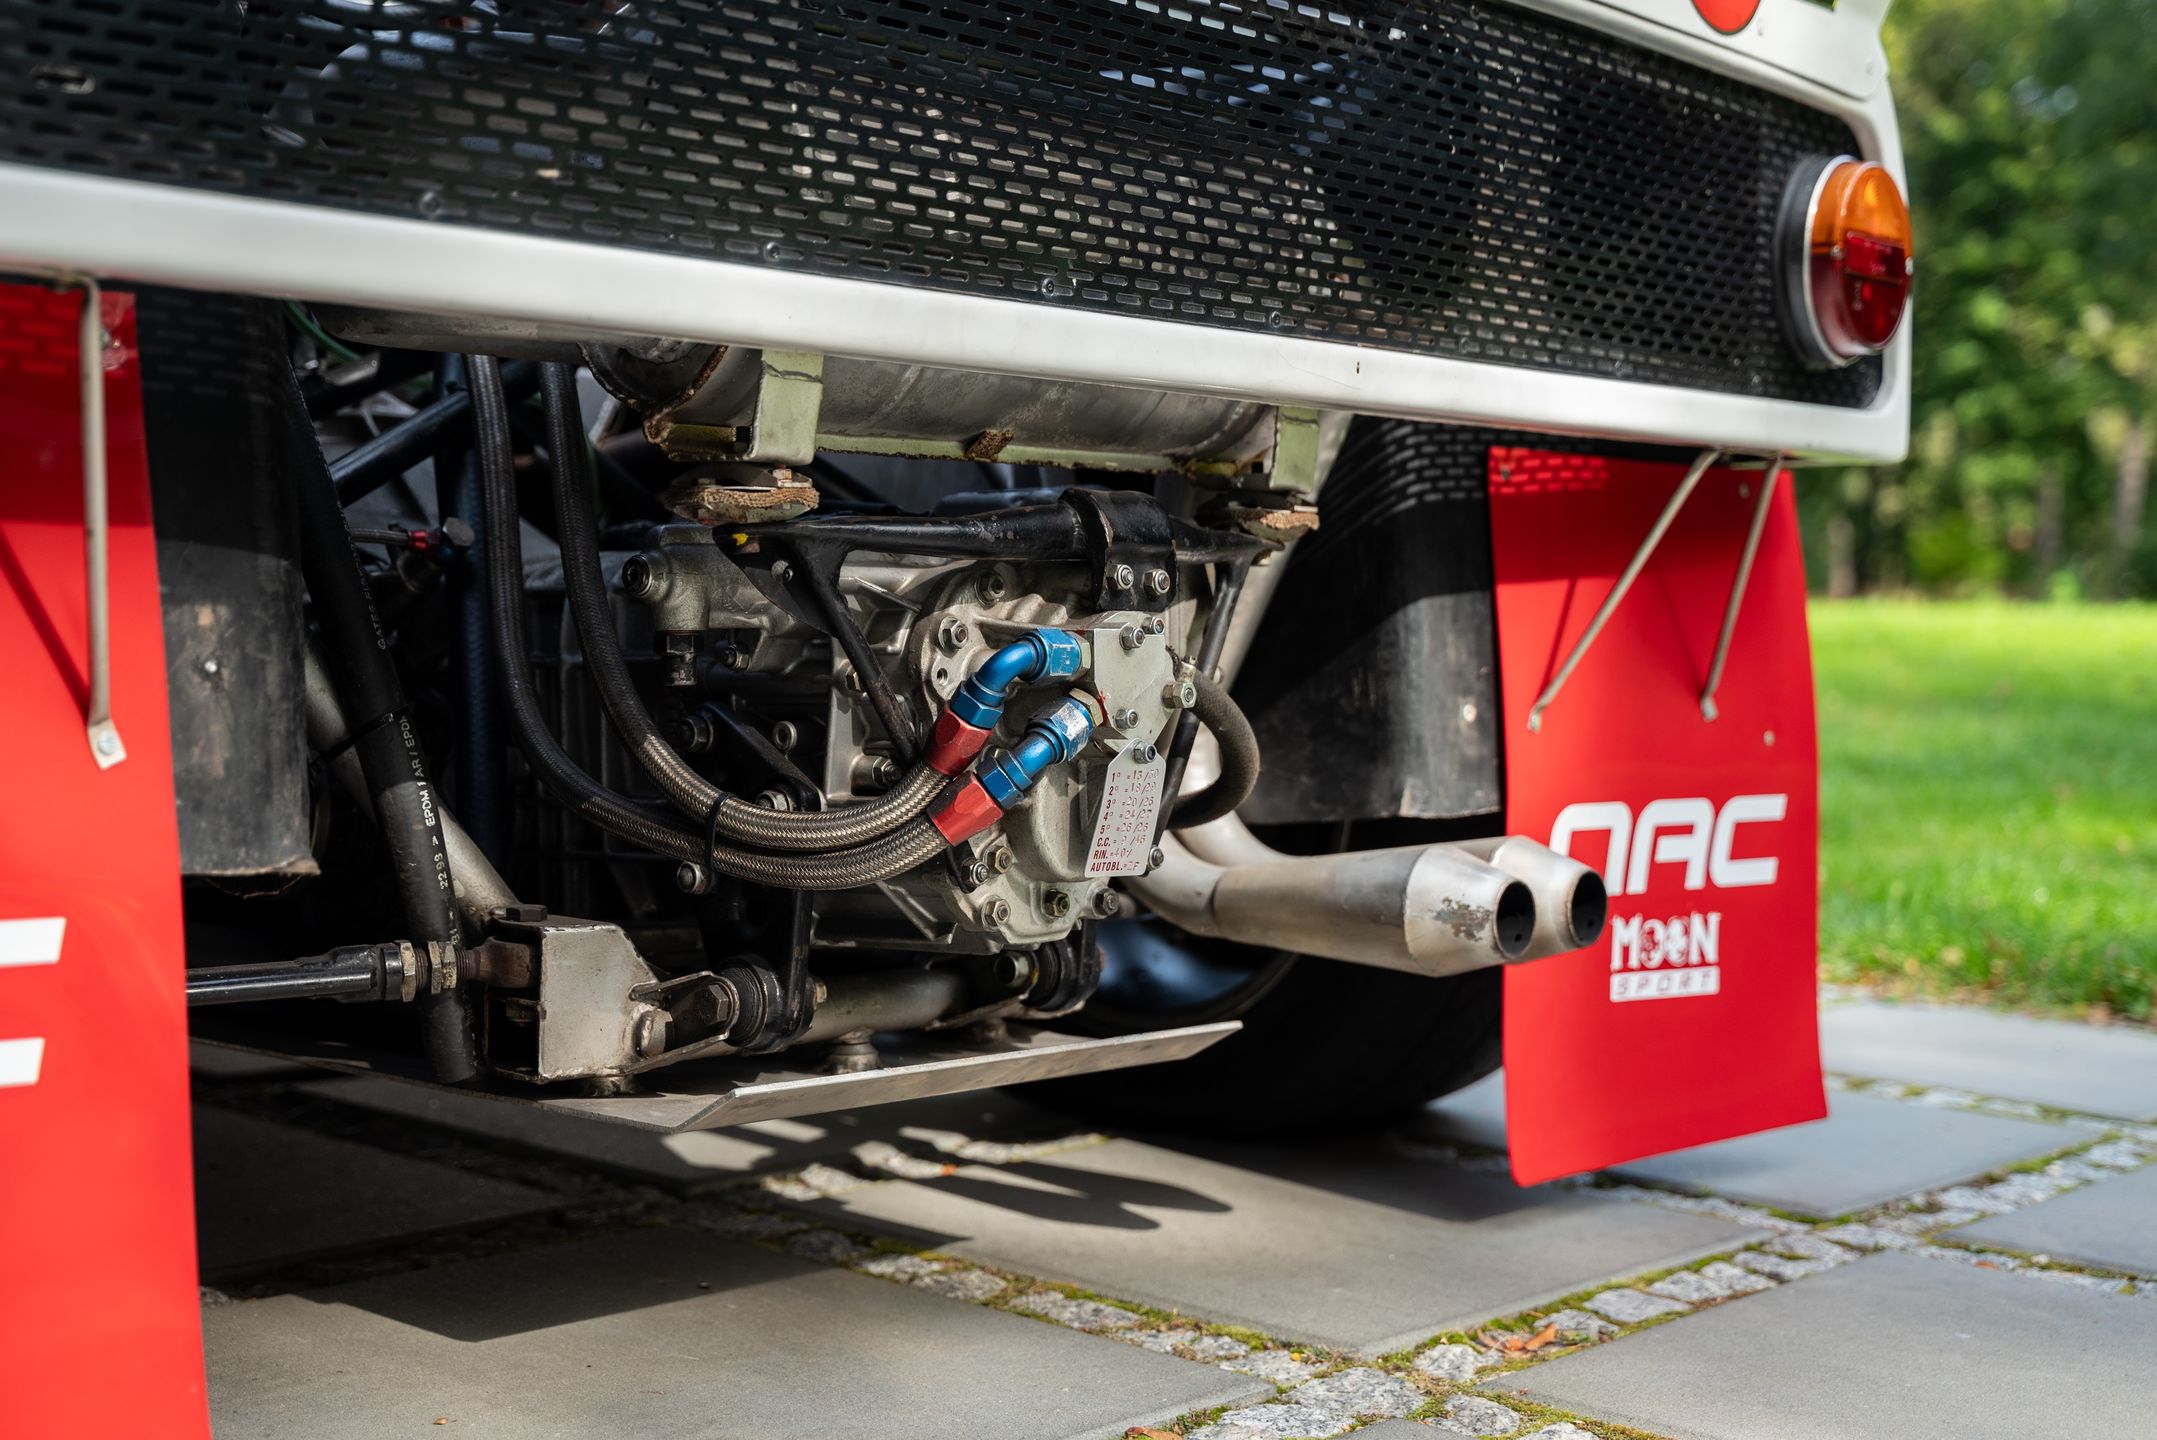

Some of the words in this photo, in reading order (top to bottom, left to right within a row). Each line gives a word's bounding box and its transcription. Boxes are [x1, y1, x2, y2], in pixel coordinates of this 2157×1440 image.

[411, 758, 425, 778] AR
[418, 789, 436, 827] EPDM
[1093, 849, 1108, 860] RIN.
[1609, 910, 1722, 973] MOON
